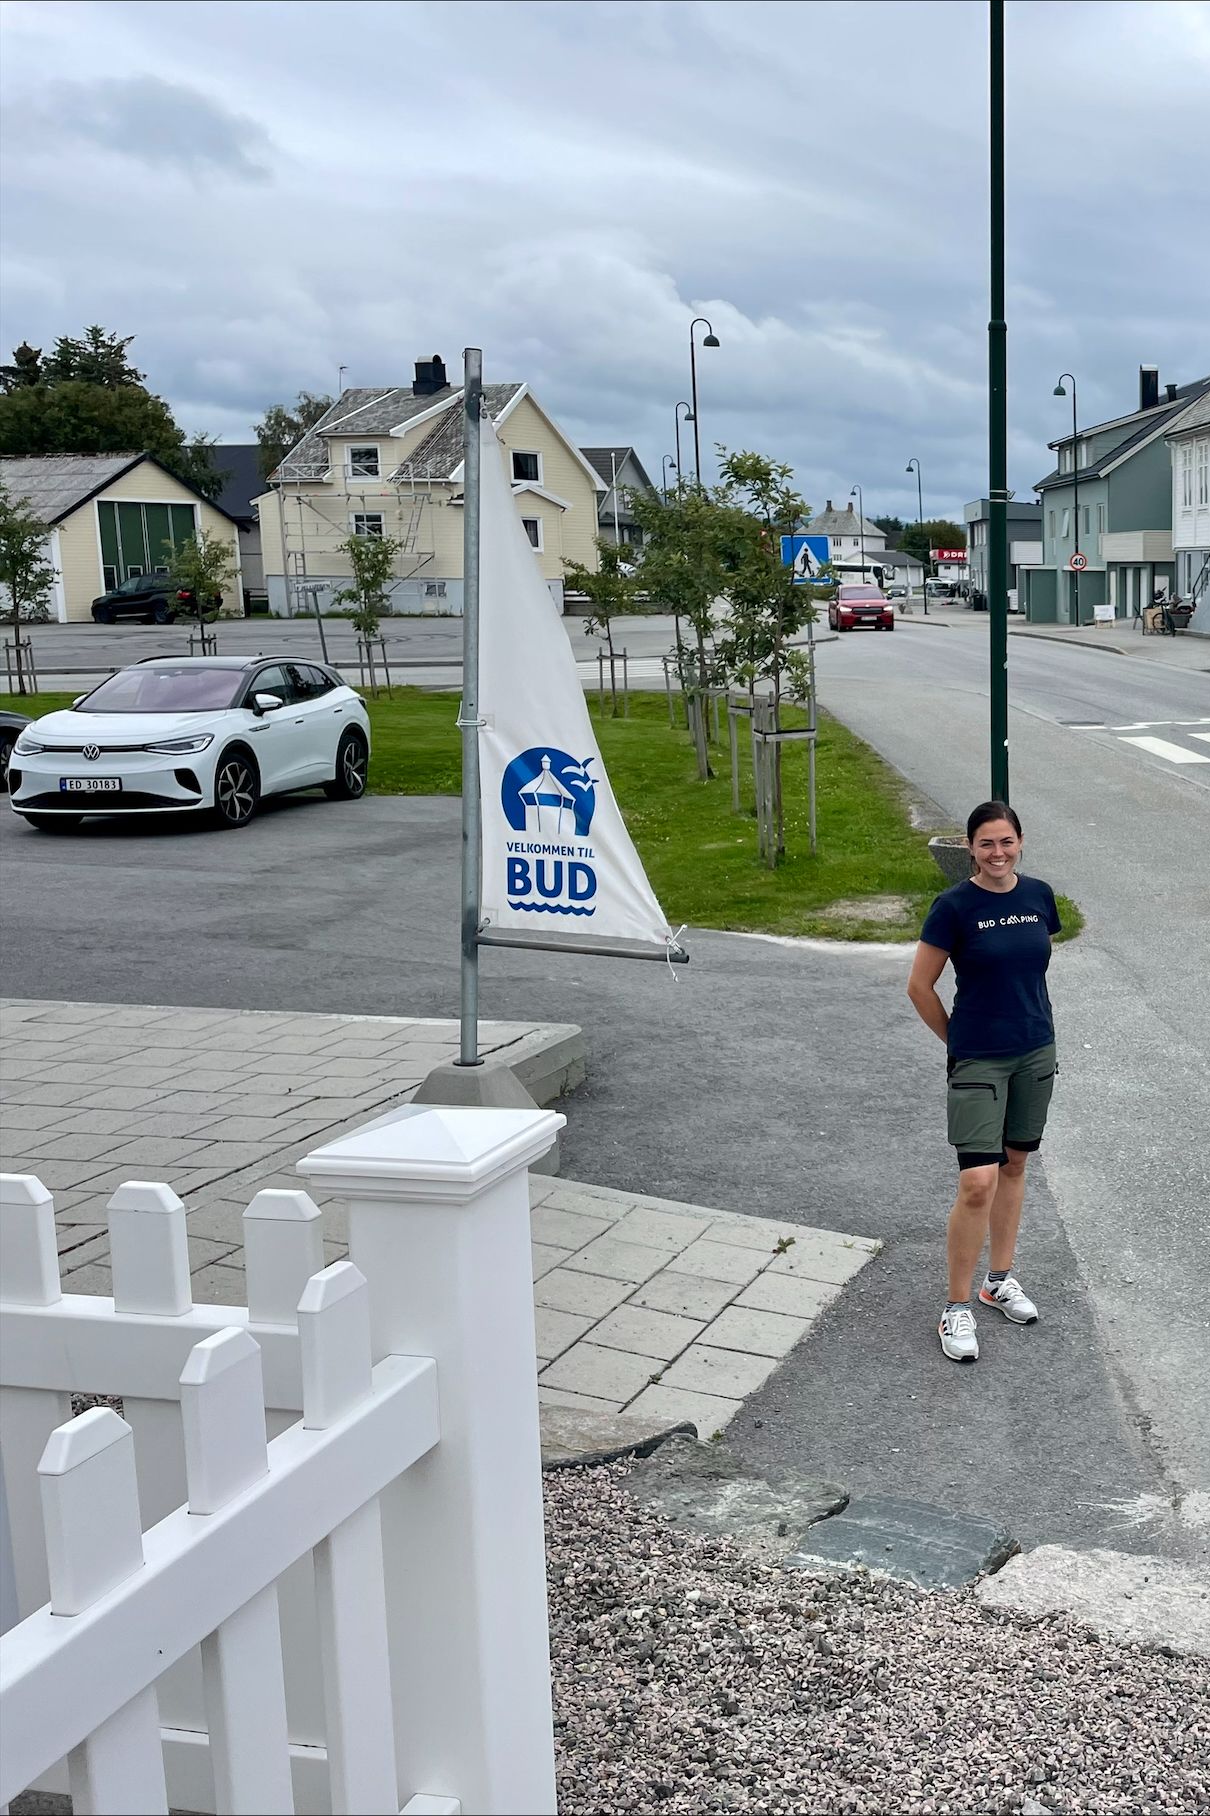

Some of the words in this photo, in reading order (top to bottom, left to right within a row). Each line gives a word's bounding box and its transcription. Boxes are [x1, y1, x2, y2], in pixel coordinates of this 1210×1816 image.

[1073, 557, 1084, 566] 40
[69, 780, 82, 790] ED
[86, 780, 117, 790] 30183
[506, 841, 575, 857] VELKOMMEN
[577, 847, 596, 859] TIL
[506, 856, 598, 902] BUD
[977, 919, 996, 930] BUD
[999, 914, 1039, 926] CAMPING
